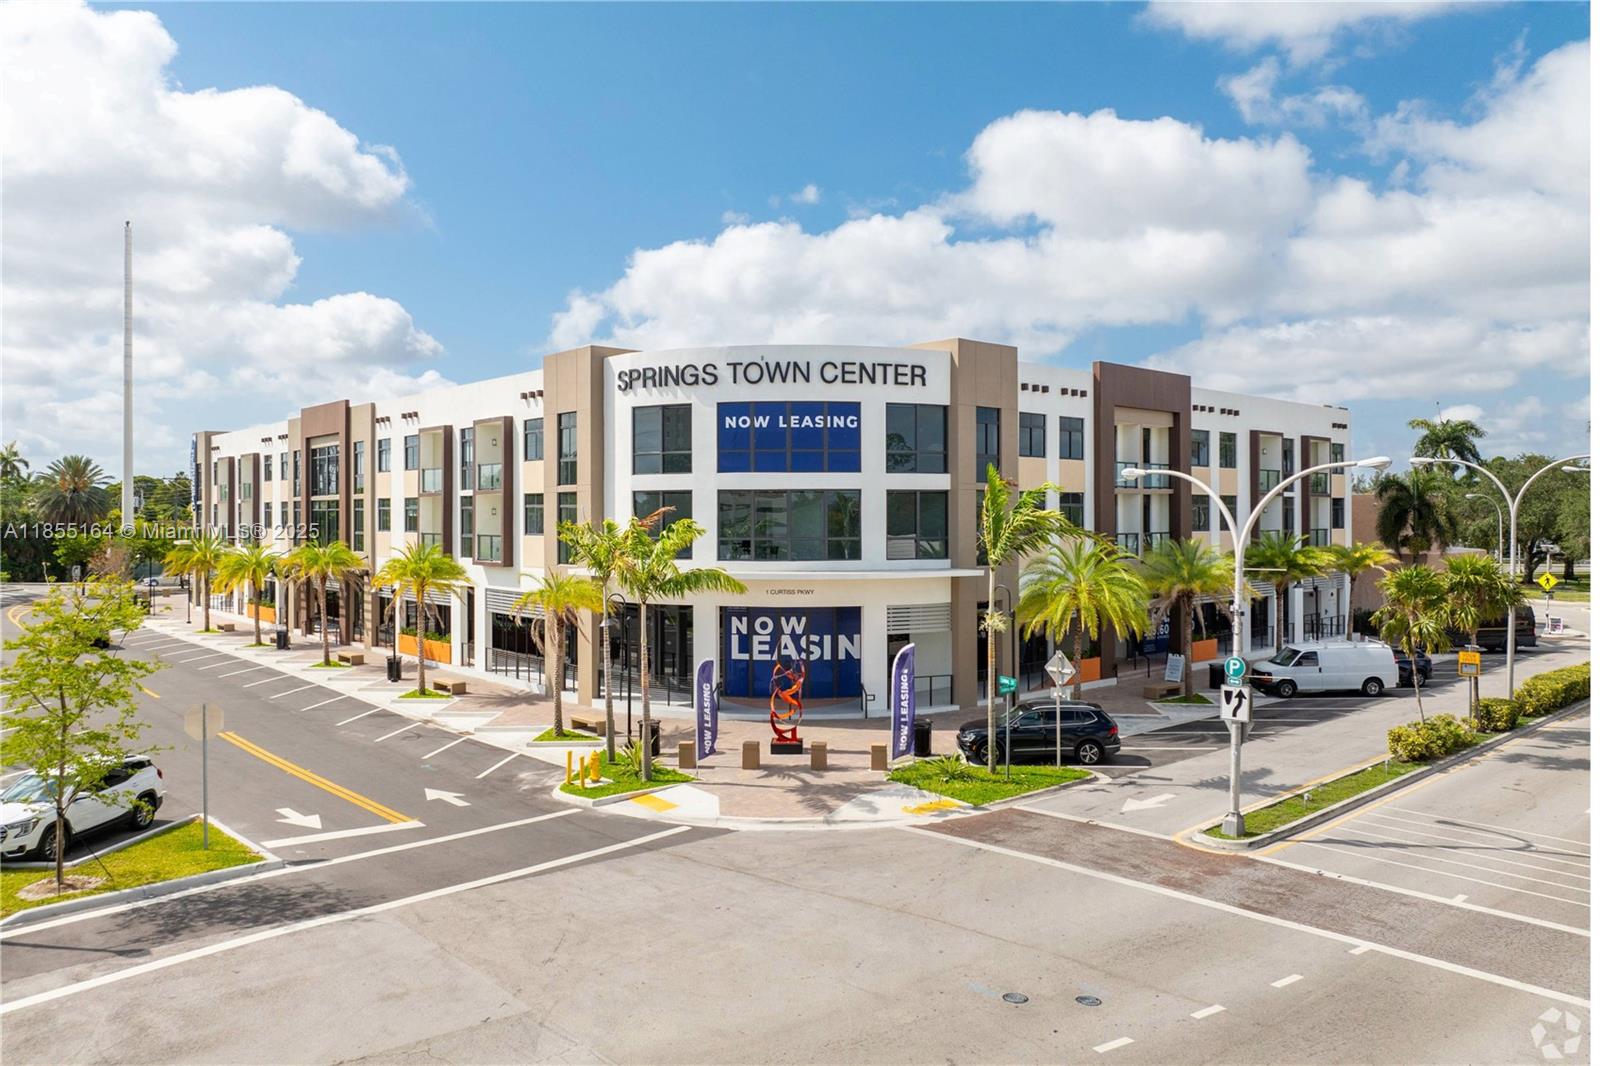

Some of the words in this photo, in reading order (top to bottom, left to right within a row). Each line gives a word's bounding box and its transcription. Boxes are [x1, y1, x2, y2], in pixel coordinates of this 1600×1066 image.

[617, 363, 718, 393] SPRINGS
[726, 361, 811, 385] TOWN
[820, 361, 927, 387] CENTER
[725, 415, 769, 429] NOW
[778, 415, 859, 429] LEASING
[731, 616, 807, 634] NOW
[731, 634, 860, 660] LEASIN
[1230, 660, 1240, 675] P
[703, 682, 711, 727] LEASING
[704, 729, 712, 754] NOW
